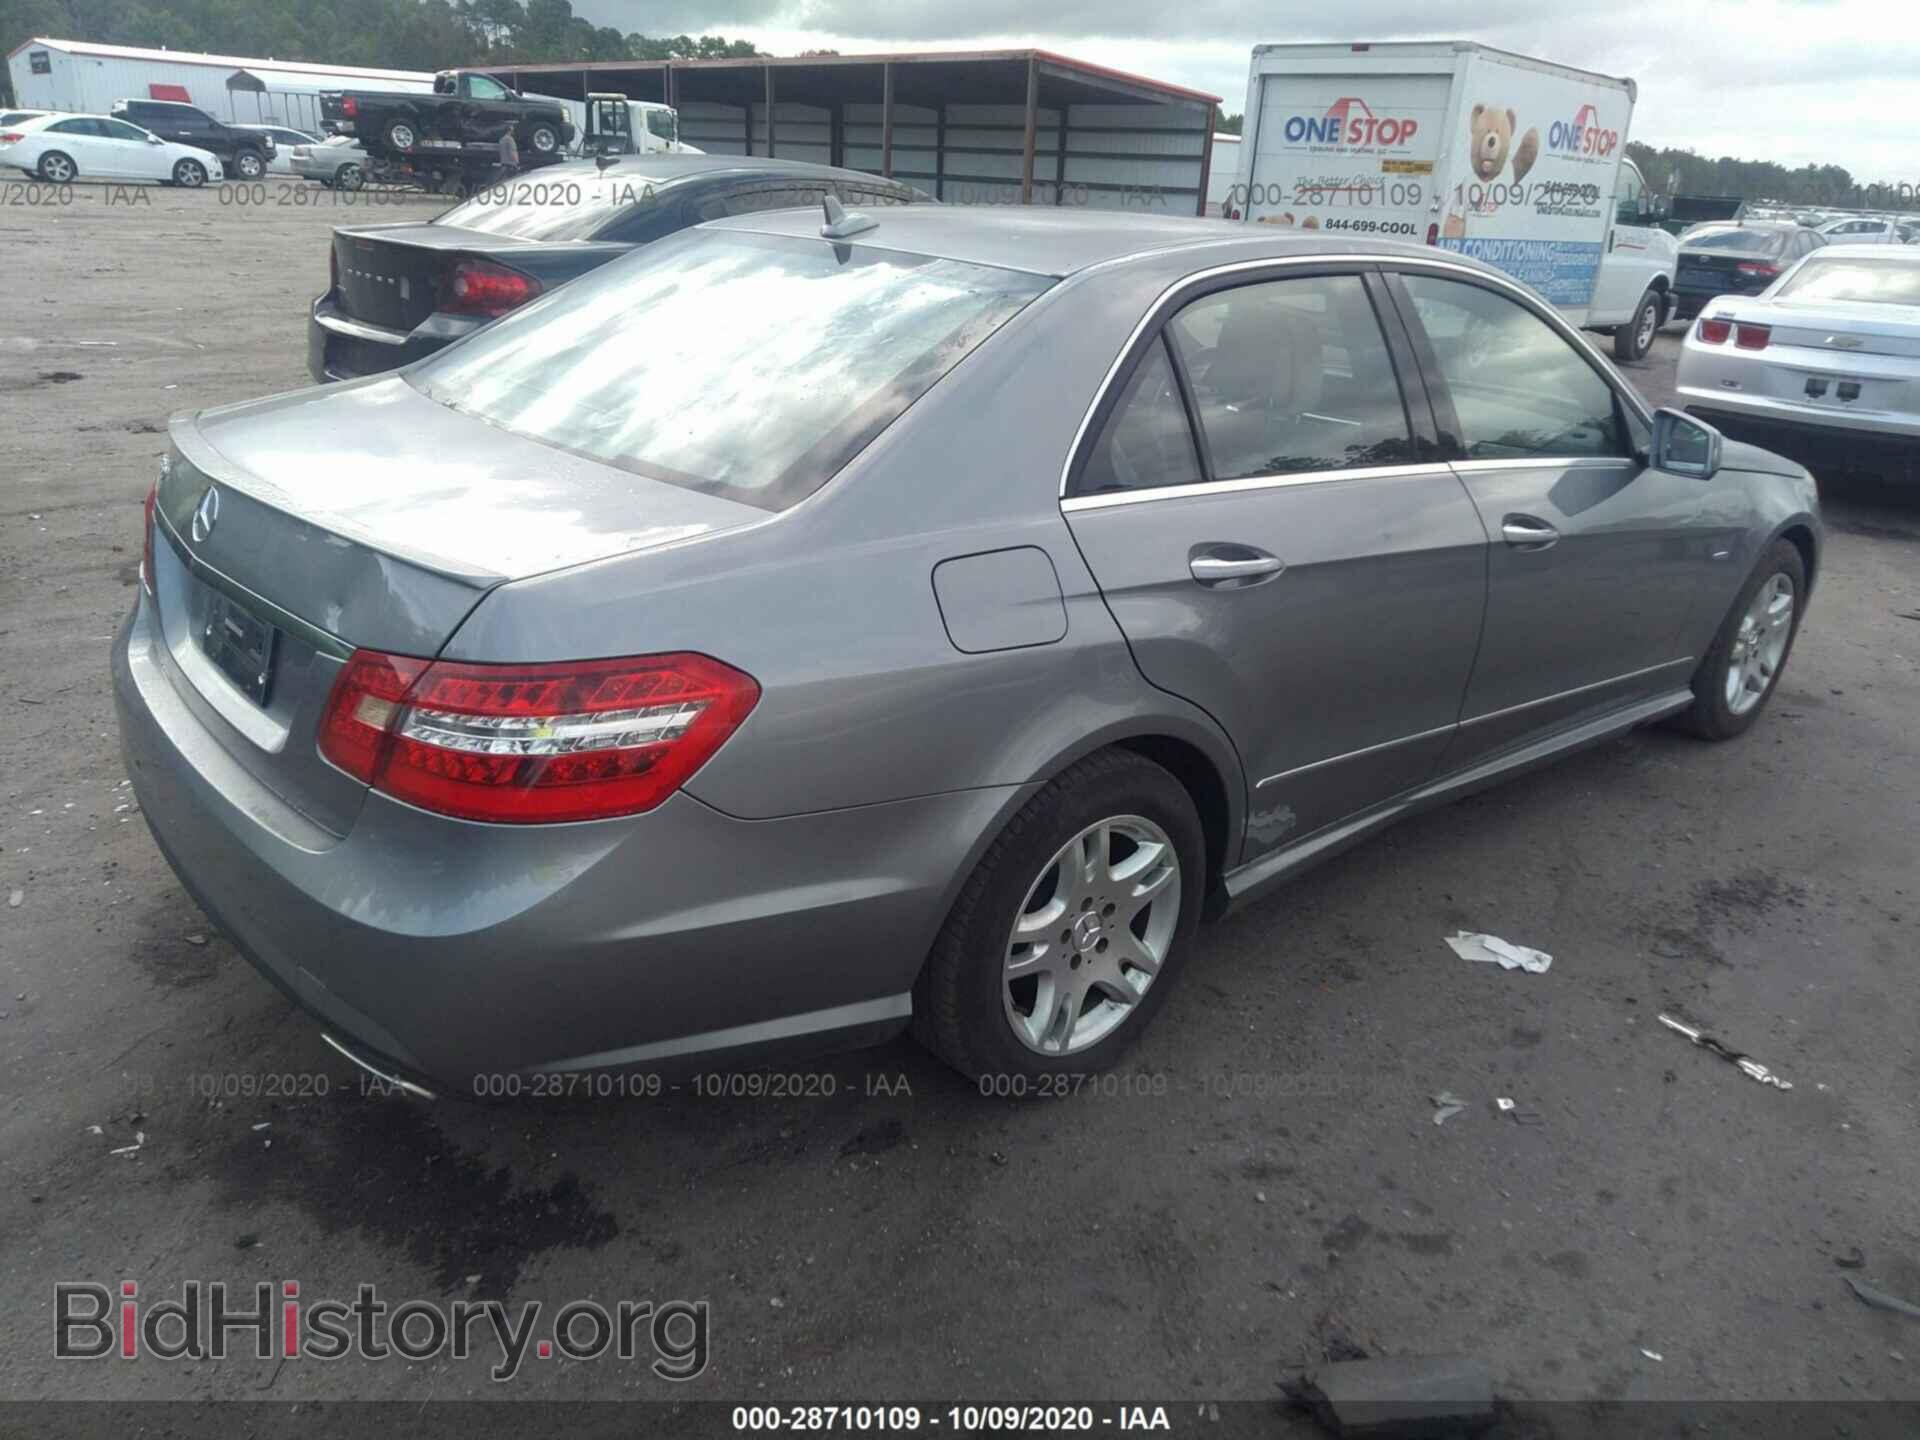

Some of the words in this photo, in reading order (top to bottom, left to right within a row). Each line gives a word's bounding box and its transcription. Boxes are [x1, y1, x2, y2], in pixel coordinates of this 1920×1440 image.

[1284, 116, 1340, 143] ONE
[1347, 118, 1418, 146] STOP
[1549, 121, 1580, 152] ONE
[1583, 128, 1617, 156] STOP
[1297, 176, 1313, 186] The
[1325, 218, 1418, 235] 844-699-COOL
[1463, 239, 1554, 262] CONDITIONING
